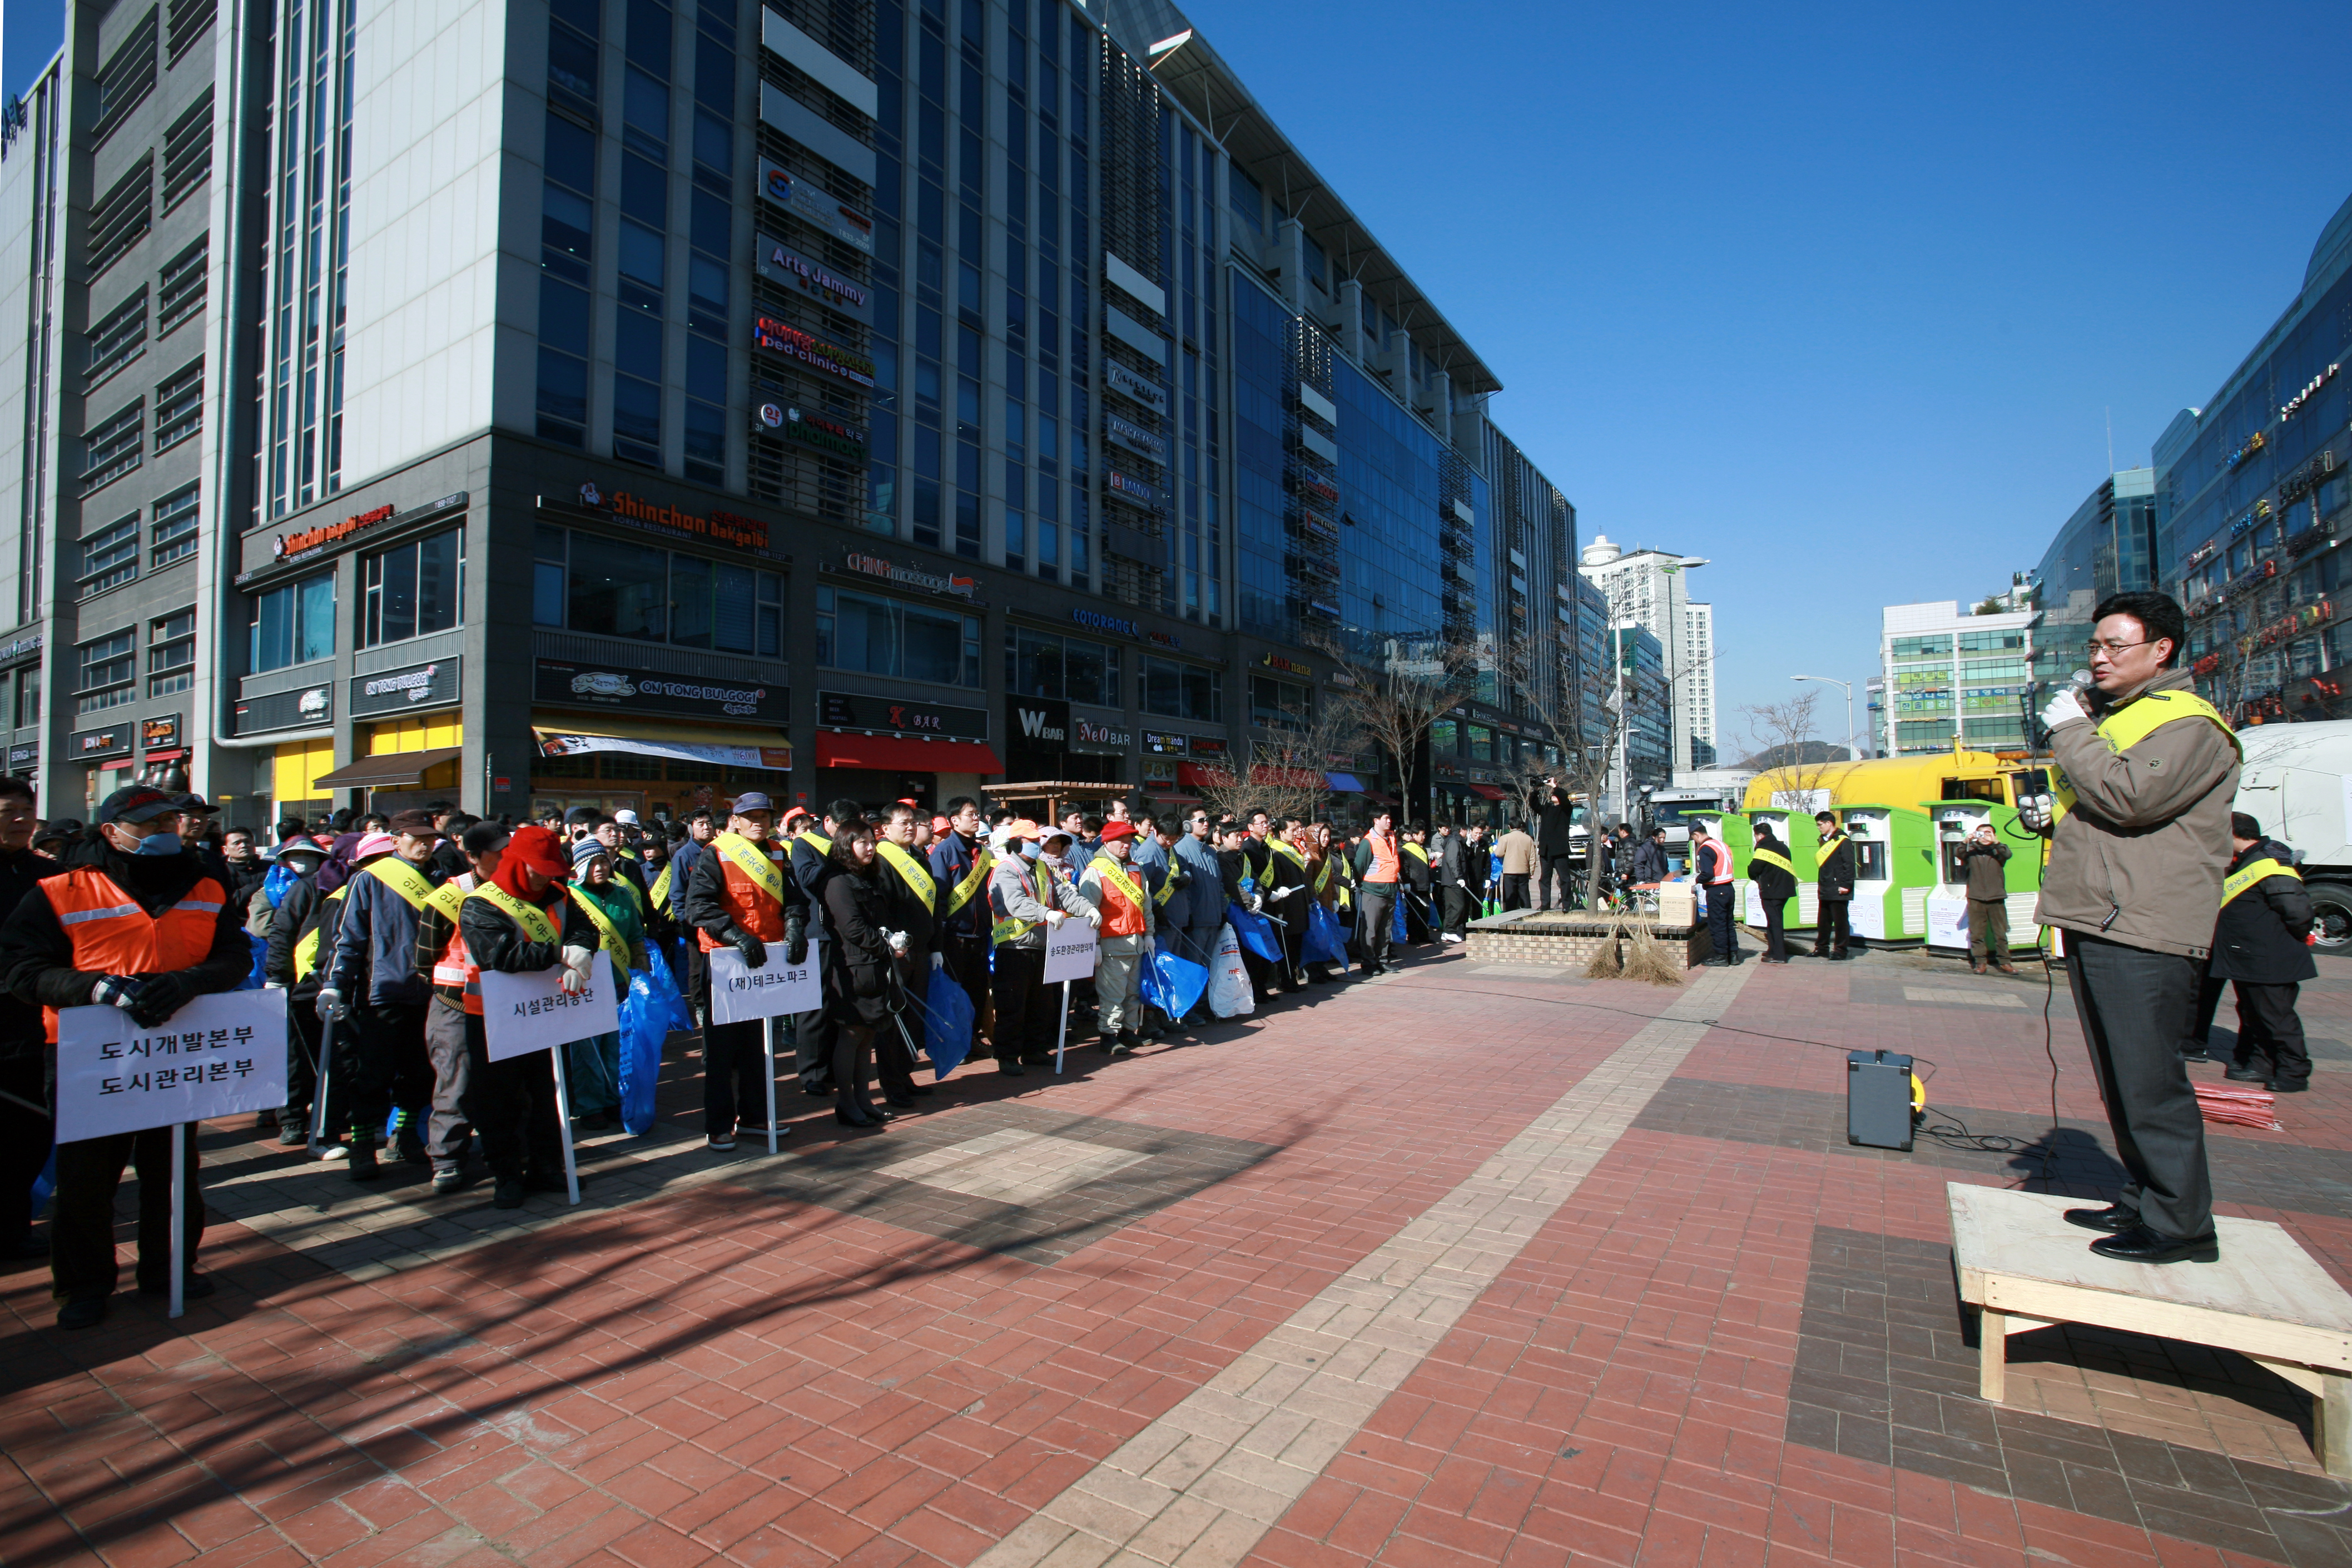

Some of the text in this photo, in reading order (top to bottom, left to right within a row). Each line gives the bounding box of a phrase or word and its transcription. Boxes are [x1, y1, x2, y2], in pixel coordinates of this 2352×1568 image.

[760, 266, 769, 275] 5F
[771, 247, 866, 306] Arts Jammy
[765, 406, 780, 425] 약
[755, 424, 764, 433] 3F
[787, 421, 867, 460] pharmacy
[845, 429, 863, 444] 약국
[1114, 420, 1133, 437] MATH
[1133, 430, 1163, 453] ACADEMY
[1122, 478, 1152, 500] BANDO
[613, 491, 706, 534] Shinchon
[712, 509, 768, 533] 신촌닭갈비
[613, 514, 692, 540] KOREA RESTAURANT
[709, 521, 769, 548] Dakgalbi
[286, 526, 325, 555] Shinchon
[758, 549, 786, 560] 858-1127
[847, 553, 890, 578] CHINA
[1072, 608, 1130, 634] EOTORANG
[1272, 654, 1311, 676] BAR nana
[365, 672, 431, 695] ON TONG BULGOGI
[641, 680, 758, 704] ON TONG BULGOGI
[889, 706, 941, 730] K BAR
[1018, 708, 1064, 741] W BAR
[1110, 733, 1130, 746] BAR
[1147, 733, 1183, 746] Dream mandu
[738, 848, 767, 875] 깨끗한
[906, 866, 928, 890] 깨끗한
[1050, 942, 1094, 957] 송도환경관리협의체
[729, 969, 808, 993] (재)테크노파크
[99, 1025, 254, 1060] 도시개발본부
[99, 1058, 255, 1095] 도시관리본부
